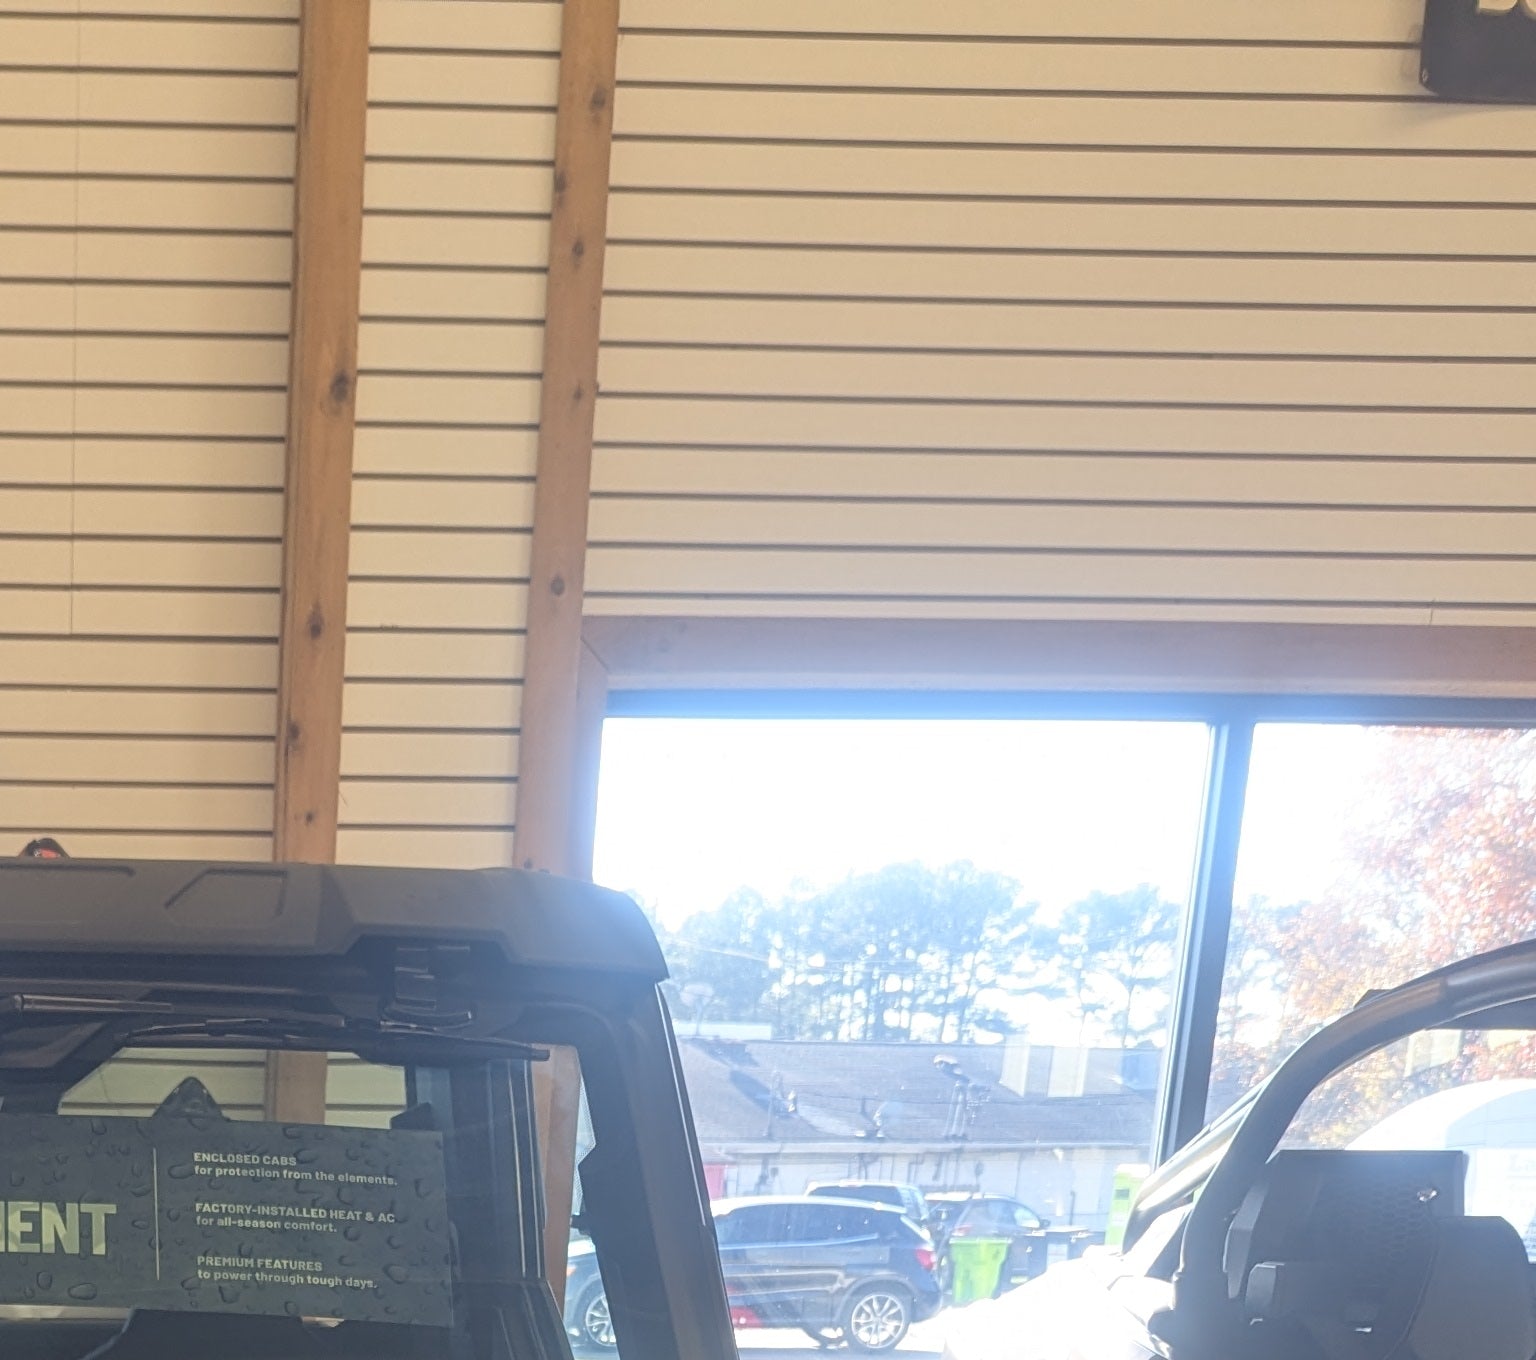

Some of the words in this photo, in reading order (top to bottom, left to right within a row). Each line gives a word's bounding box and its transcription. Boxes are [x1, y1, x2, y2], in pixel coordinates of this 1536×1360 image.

[193, 1152, 260, 1165] ENCLOSED
[262, 1155, 297, 1166] CABS
[194, 1165, 212, 1175] for
[215, 1166, 280, 1178] protection
[282, 1169, 312, 1180] from
[315, 1171, 335, 1182] the
[338, 1172, 398, 1186] elements.
[195, 1202, 327, 1219] FACTORY-INSTALLED
[330, 1209, 362, 1221] HEAT
[365, 1212, 374, 1222] &
[378, 1212, 396, 1223] AC
[196, 1215, 214, 1226] for
[217, 1216, 281, 1229] all-season
[284, 1221, 337, 1232] comfort.
[197, 1255, 254, 1268] PREMIUM
[257, 1259, 323, 1271] FEATURES
[197, 1269, 211, 1279] to
[214, 1272, 252, 1282] power
[255, 1272, 304, 1286] through
[307, 1276, 342, 1288] tough
[345, 1277, 378, 1290] days.
